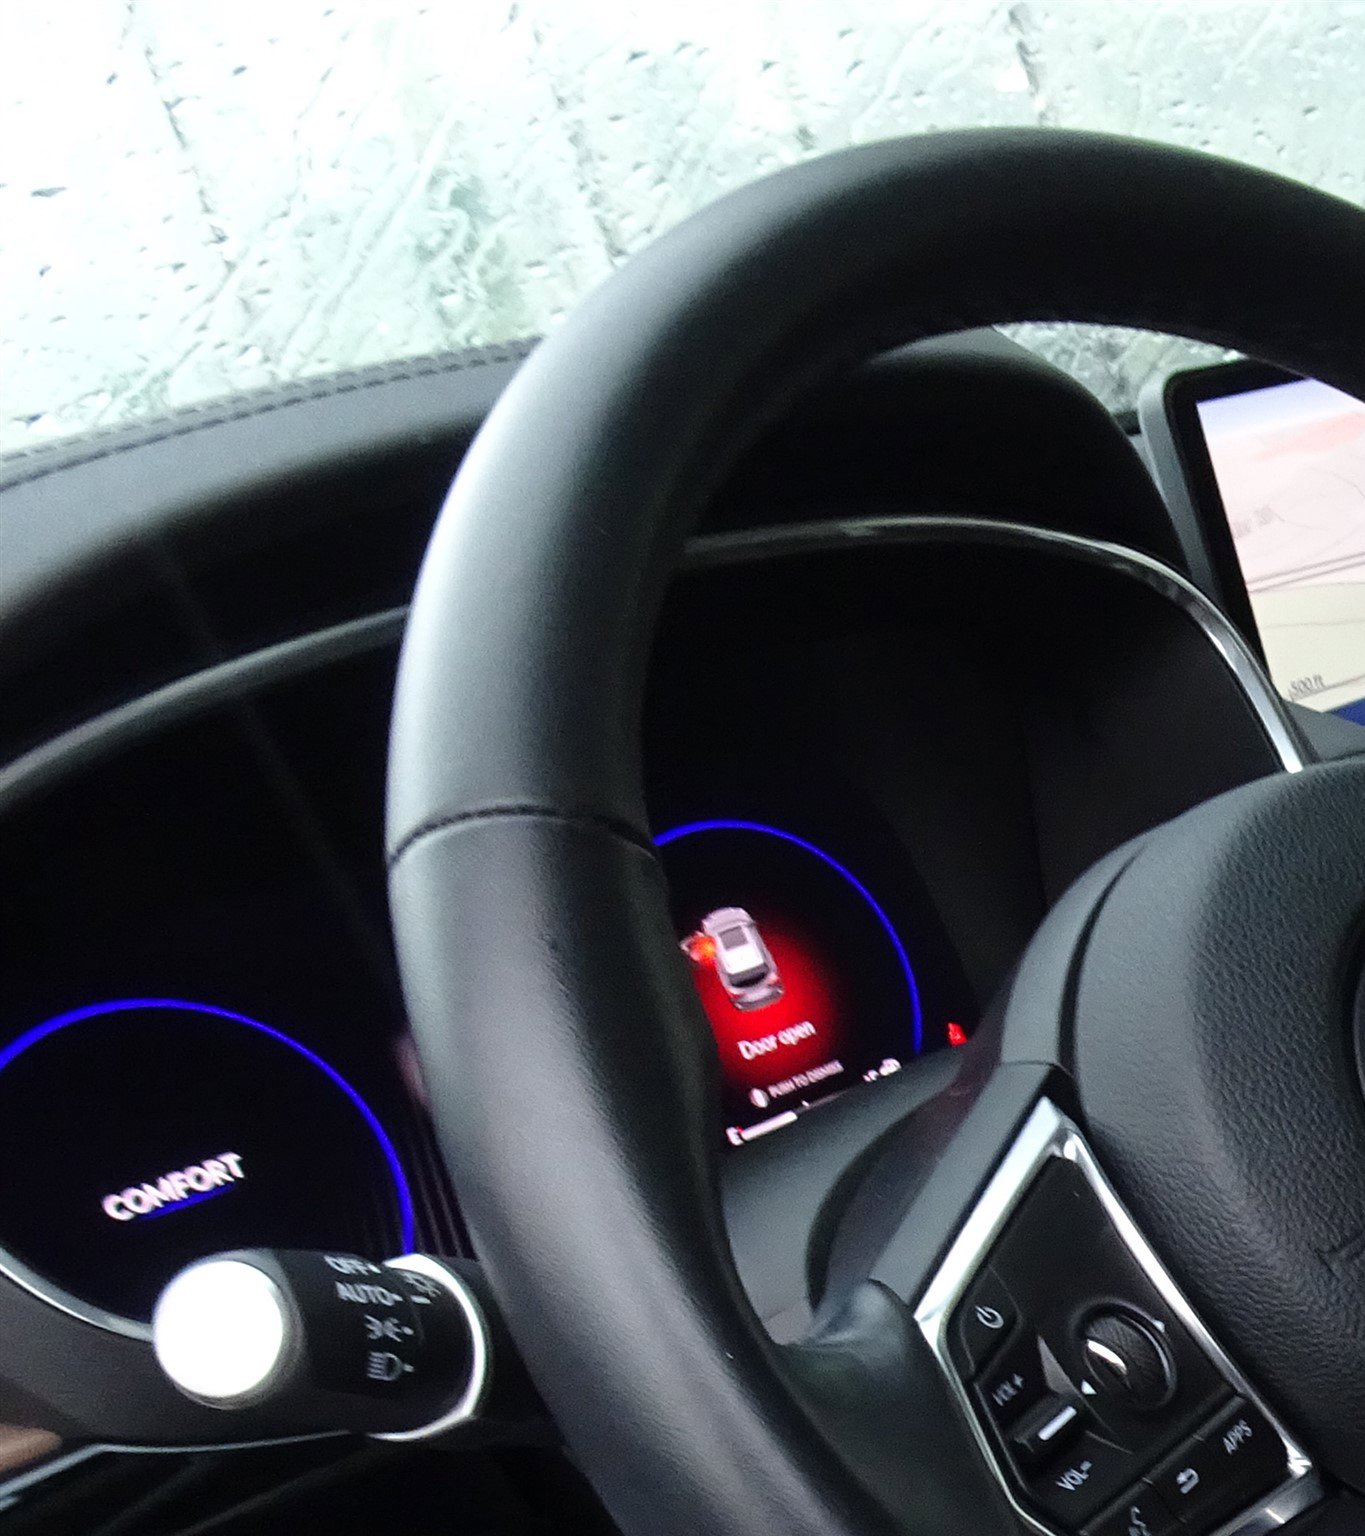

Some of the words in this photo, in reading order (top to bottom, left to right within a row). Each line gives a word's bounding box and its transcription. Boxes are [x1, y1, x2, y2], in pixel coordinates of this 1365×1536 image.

[737, 1036, 778, 1060] Door
[779, 1020, 816, 1045] open
[101, 1151, 245, 1221] COMFORT
[335, 1281, 396, 1307] AUTO
[1222, 1419, 1253, 1455] APPS
